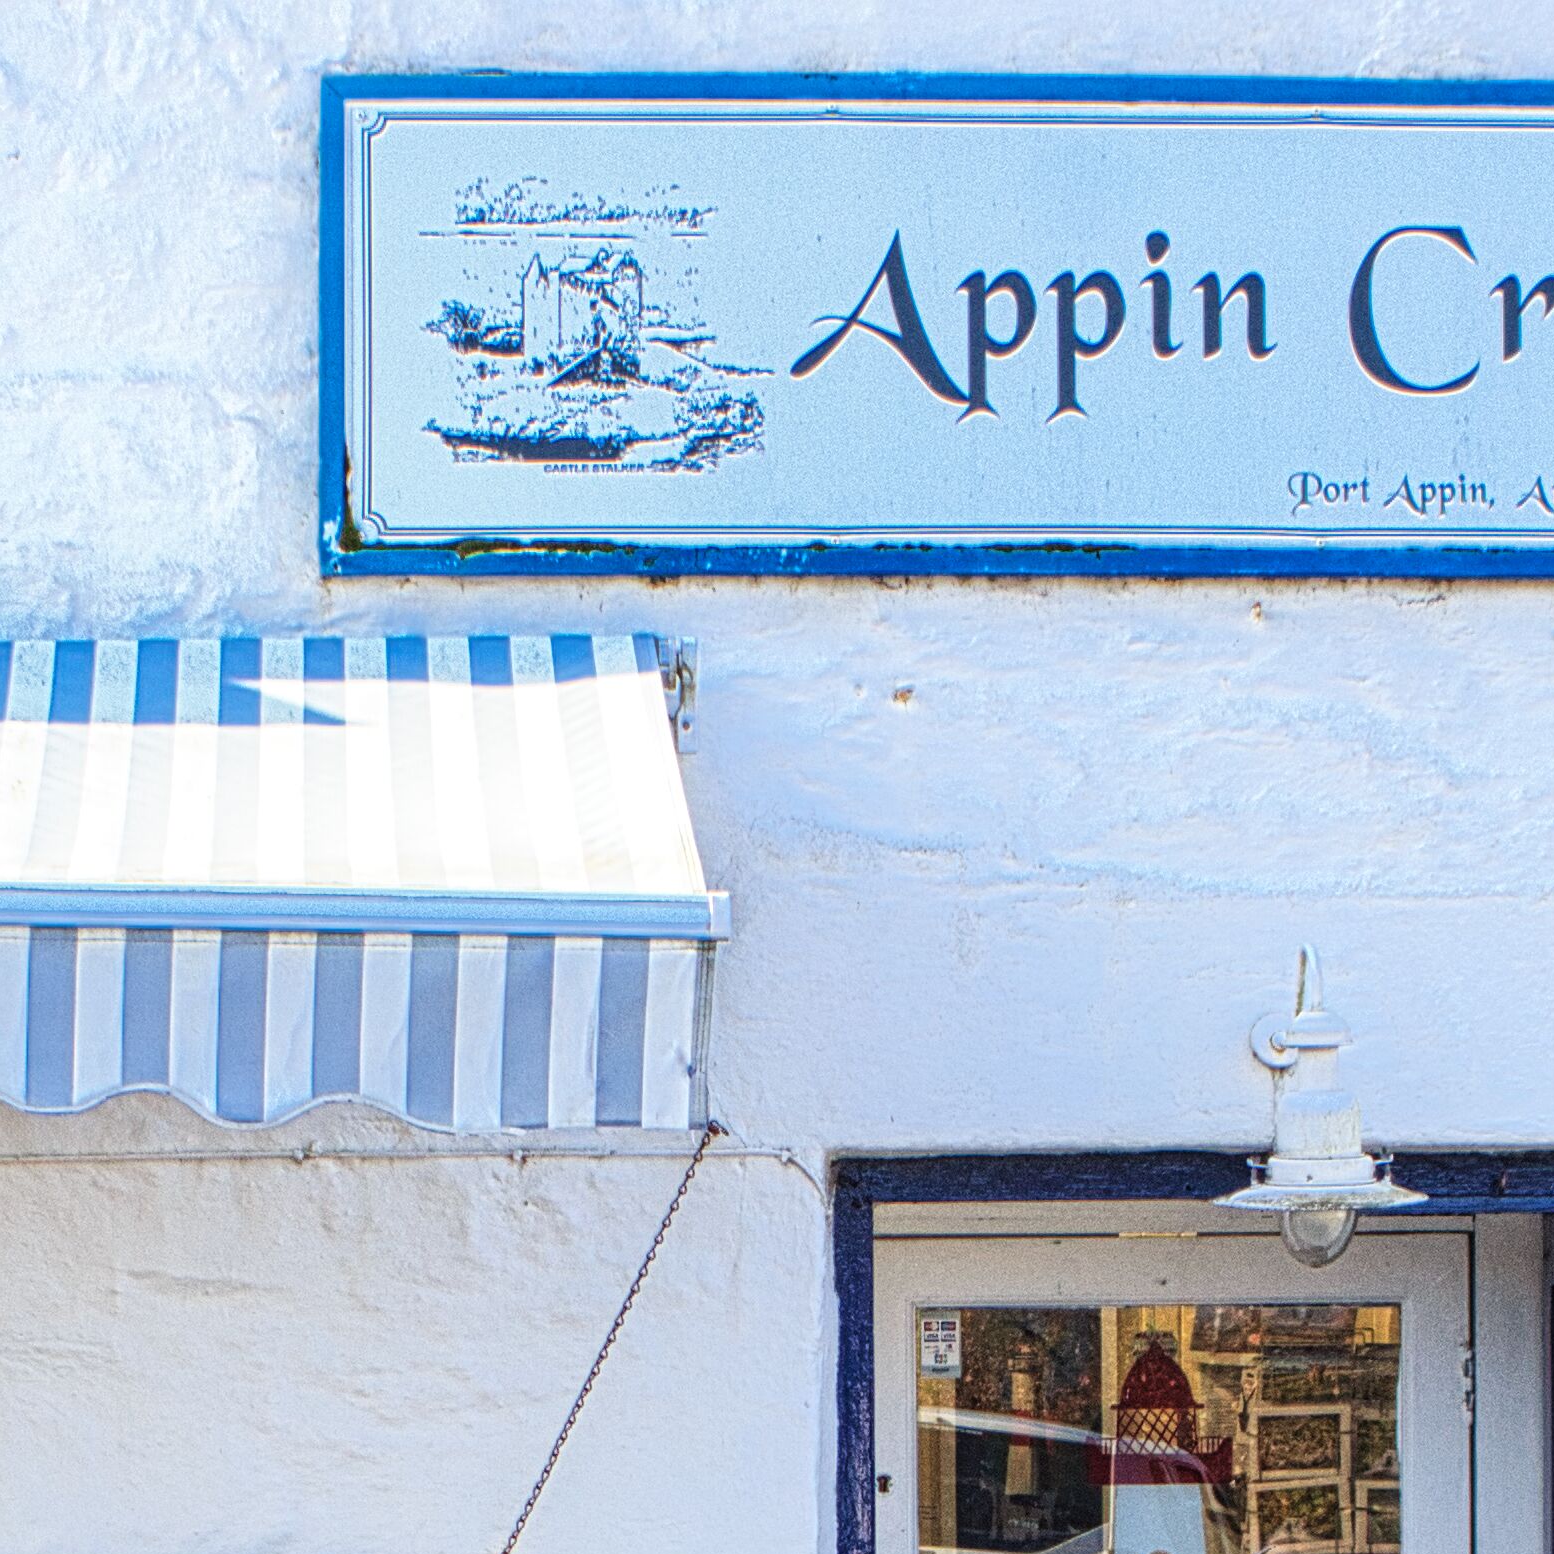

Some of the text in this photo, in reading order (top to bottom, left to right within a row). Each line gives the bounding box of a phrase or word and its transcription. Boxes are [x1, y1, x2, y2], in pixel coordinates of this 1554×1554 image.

[790, 228, 1277, 422] Appin
[543, 463, 589, 474] CASTLE
[1288, 471, 1370, 517] Port
[1383, 472, 1496, 516] Appin,
